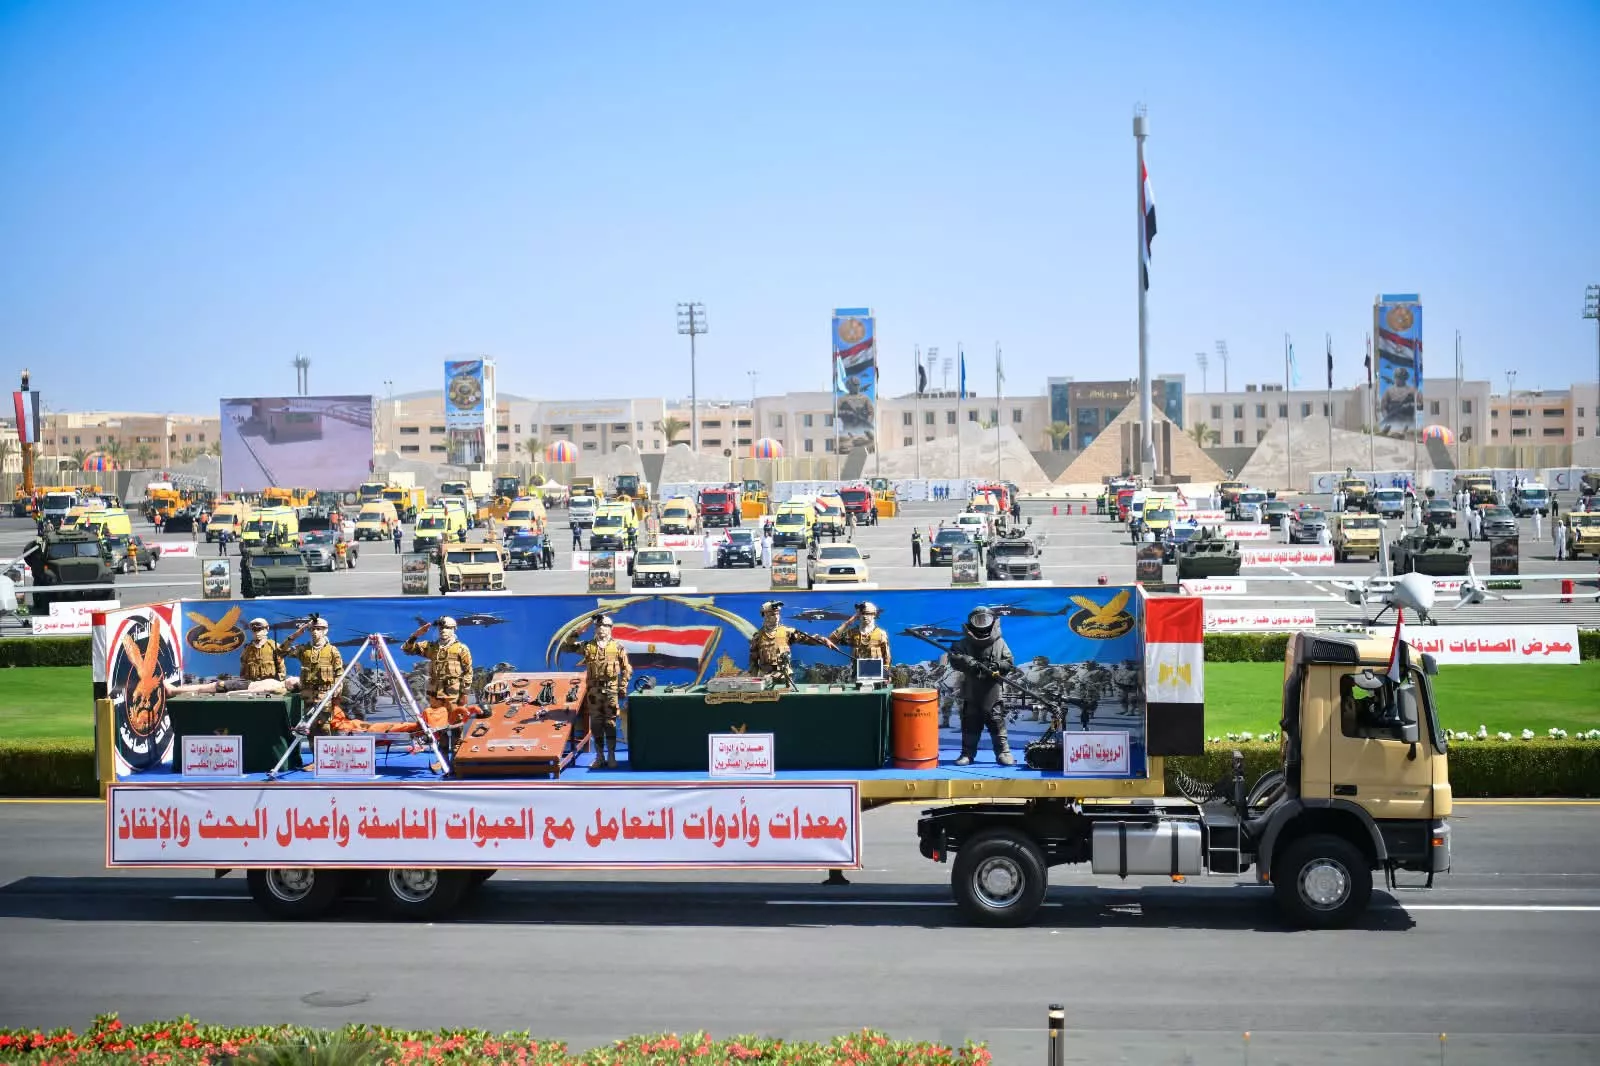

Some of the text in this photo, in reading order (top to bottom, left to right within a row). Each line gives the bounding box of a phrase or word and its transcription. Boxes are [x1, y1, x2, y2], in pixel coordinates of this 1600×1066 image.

[1449, 637, 1517, 653] الصناعات
[1521, 637, 1573, 656] معرض
[118, 796, 847, 850] معدات وأدوات التعامل مع العبوات الناسفة وأعمال البحث والإنقاذ
